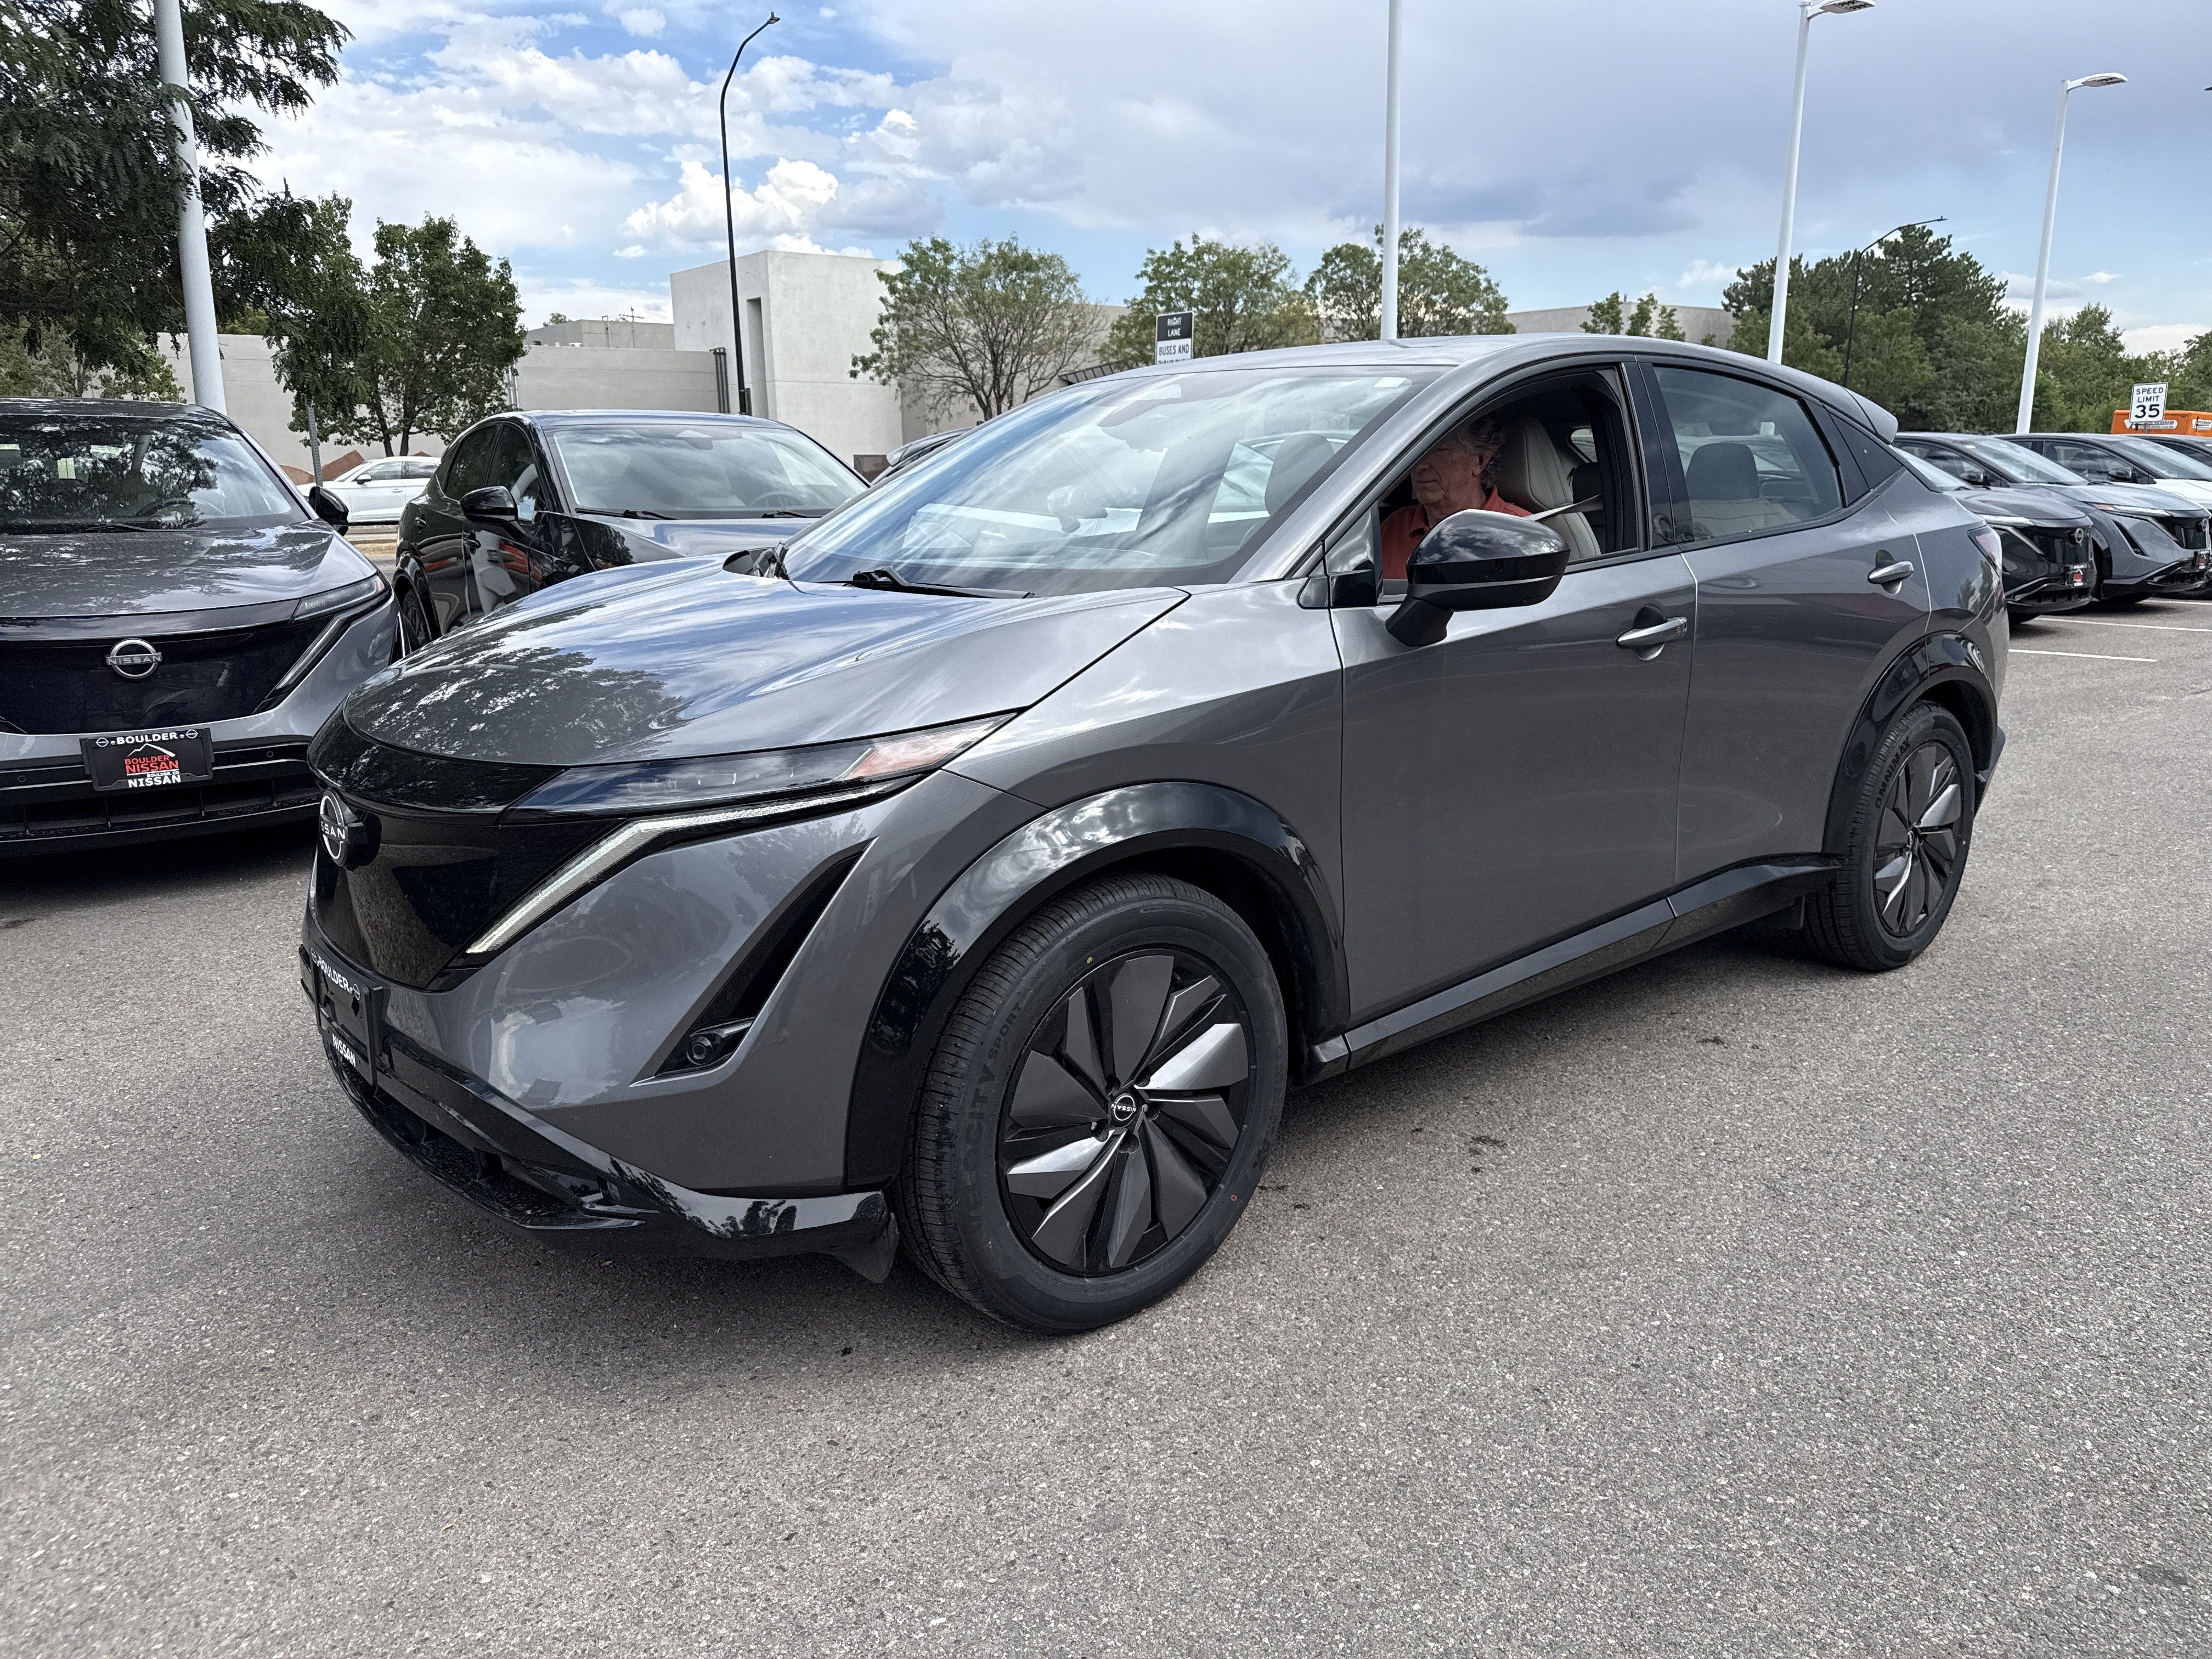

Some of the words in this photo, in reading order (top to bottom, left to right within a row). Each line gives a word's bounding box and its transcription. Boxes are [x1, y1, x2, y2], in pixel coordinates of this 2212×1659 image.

[1167, 317, 1182, 326] RIGHT
[1167, 328, 1181, 337] LANE
[1159, 345, 1176, 356] BUSES
[1178, 344, 1189, 354] AND
[2136, 387, 2164, 395] SPEED
[2134, 404, 2160, 419] 35
[108, 656, 161, 664] NISSAN
[116, 732, 178, 745] BOULDER
[125, 755, 170, 765] BOULDER
[125, 760, 179, 774] NISSAN
[1875, 736, 1910, 809] OMNIMAX
[128, 775, 181, 788] NISSAN
[320, 821, 346, 839] SSAN
[988, 1001, 1022, 1060] SPORT
[332, 1033, 357, 1068] NISSAN
[1111, 1103, 1137, 1112] NISSAN
